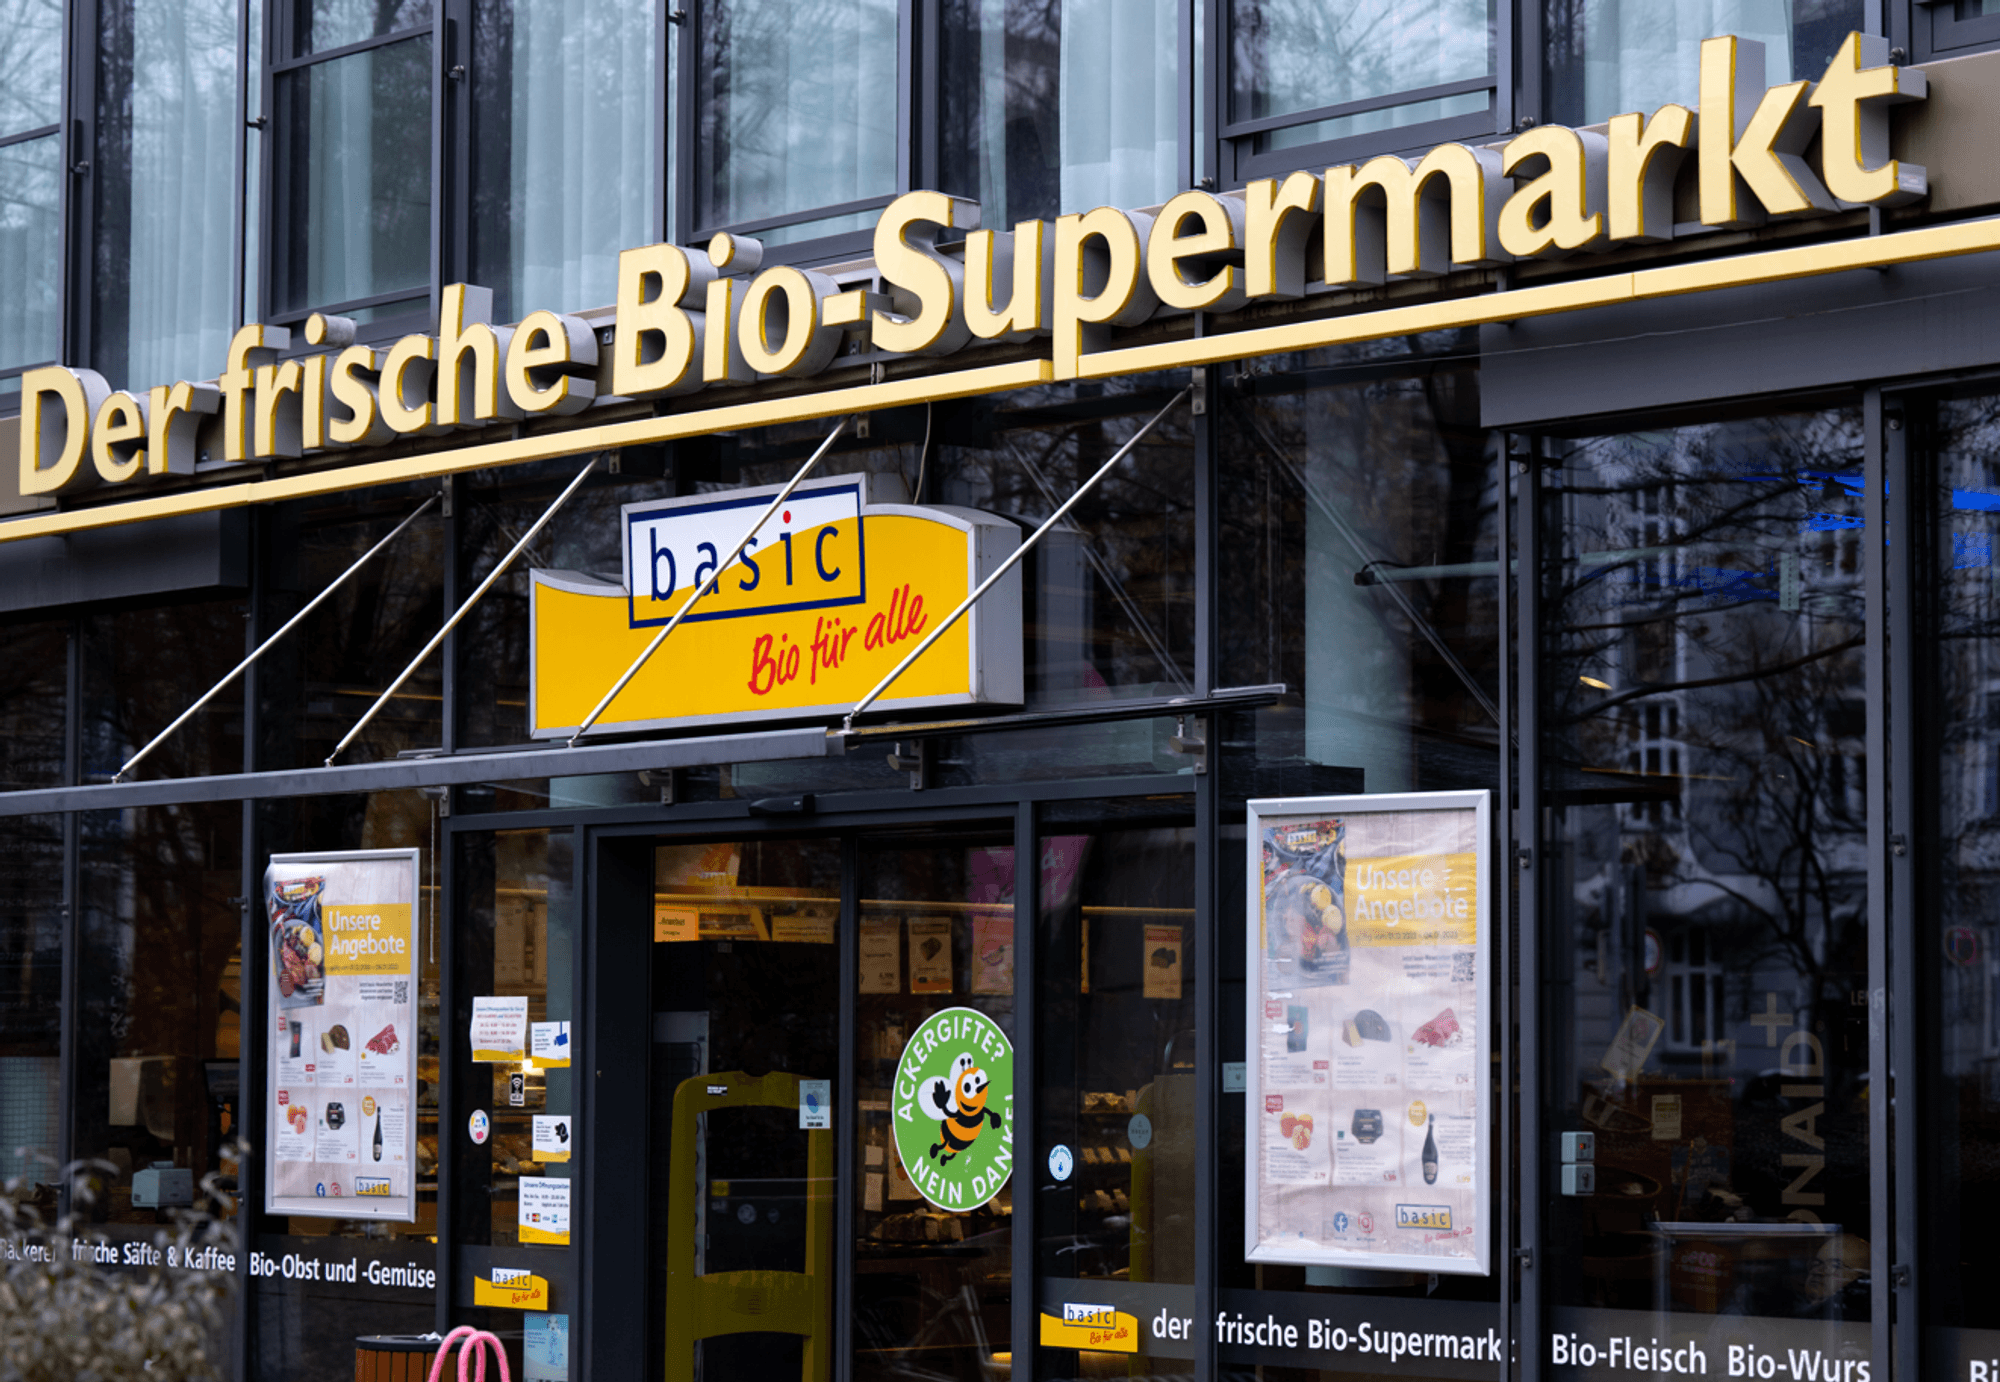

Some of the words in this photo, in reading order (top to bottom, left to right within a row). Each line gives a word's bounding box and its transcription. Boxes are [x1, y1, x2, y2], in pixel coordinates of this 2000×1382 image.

[19, 364, 202, 496] Der
[220, 282, 582, 462] frische
[612, 31, 1905, 395] Bio-Supermarkt
[649, 510, 842, 602] basic
[747, 632, 801, 696] Bio
[809, 616, 858, 685] für
[864, 584, 928, 652] alle
[1355, 864, 1435, 890] Unsere
[328, 910, 381, 932] Unsere
[1354, 892, 1468, 928] Angebote
[329, 933, 406, 961] Angebote
[897, 1015, 1006, 1123] ACKERGIFTE?
[358, 1180, 389, 1194] basic
[911, 1154, 963, 1205] NEIN
[1400, 1207, 1448, 1227] basic
[122, 1241, 162, 1267] Säfte
[167, 1245, 178, 1267] &
[184, 1246, 236, 1272] Kaffee
[250, 1251, 321, 1281] Bio-Obst
[324, 1257, 357, 1283] und
[361, 1260, 436, 1290] -Gemüse
[495, 1270, 528, 1287] basic
[1067, 1305, 1111, 1325] basic
[1089, 1331, 1102, 1345] Bio
[1152, 1307, 1193, 1341] der
[1215, 1311, 1298, 1348] frische
[1307, 1318, 1516, 1363] Bio-Supermark
[1551, 1333, 1707, 1375] Bio-Fleisch
[1727, 1344, 1872, 1382] Bio-Wurs
